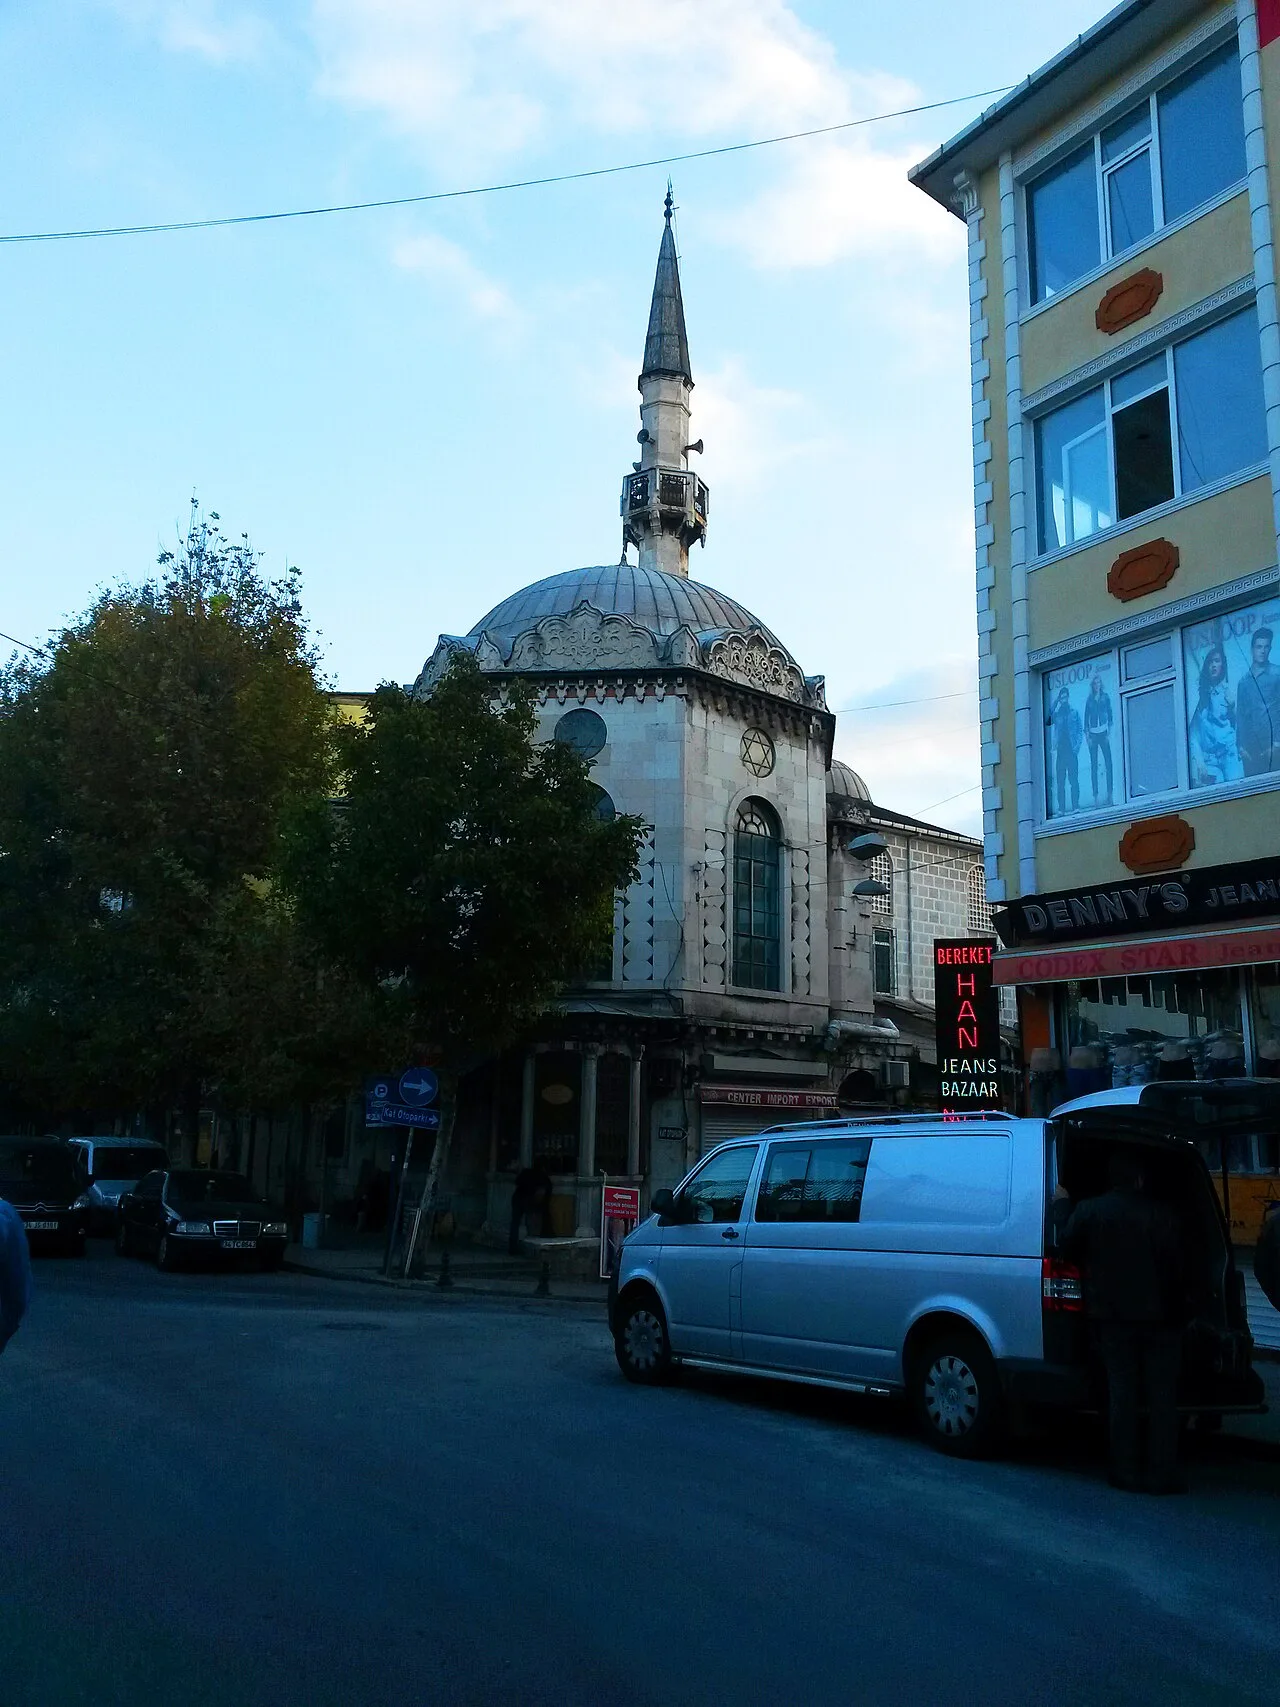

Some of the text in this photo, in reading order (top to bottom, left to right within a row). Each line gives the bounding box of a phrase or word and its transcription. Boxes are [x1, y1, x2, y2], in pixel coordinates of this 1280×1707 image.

[1022, 878, 1280, 933] DENNY'S JEAN
[937, 947, 993, 965] BEREKET
[1018, 949, 1107, 979] CODEX
[1120, 941, 1202, 972] STAR
[956, 973, 978, 1049] HAN
[941, 1058, 997, 1074] JEANS
[941, 1081, 999, 1098] BAZAAR
[728, 1092, 762, 1104] CENTER
[767, 1093, 800, 1105] IMPORT
[805, 1095, 837, 1107] EXPORT
